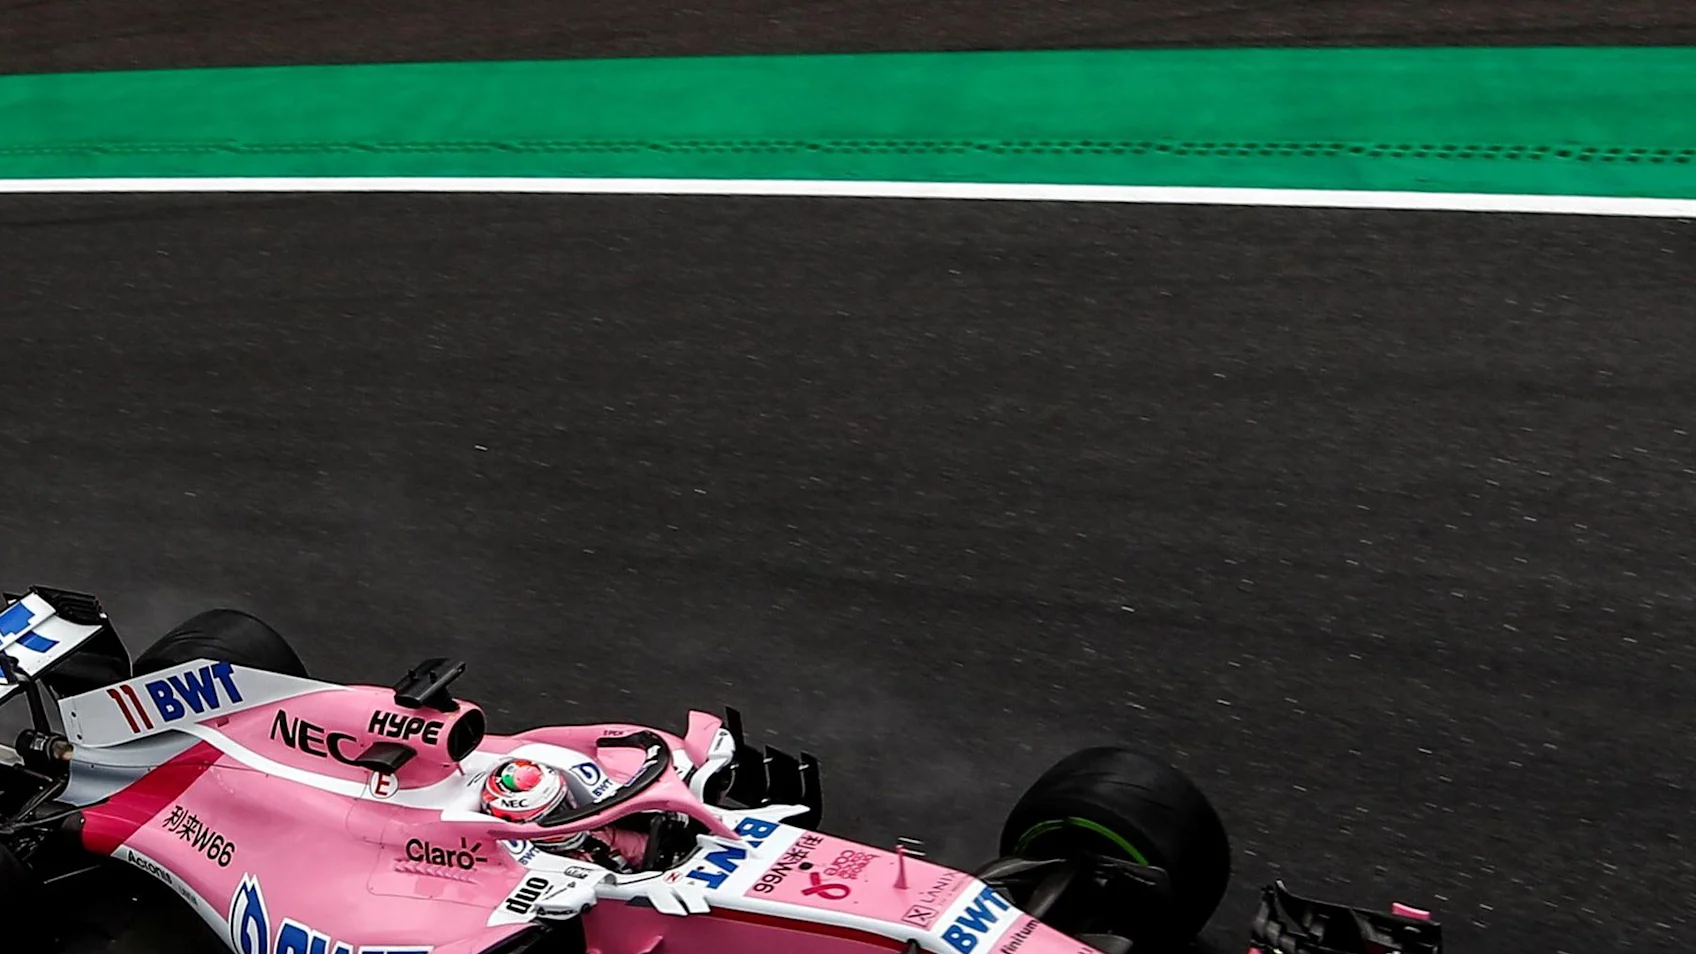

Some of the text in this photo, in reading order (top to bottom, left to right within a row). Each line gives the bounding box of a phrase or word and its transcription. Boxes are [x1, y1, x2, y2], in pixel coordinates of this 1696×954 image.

[106, 661, 243, 734] 11 BWT
[270, 709, 361, 767] NEC
[368, 711, 445, 745] HYPE
[374, 772, 391, 796] E
[500, 799, 529, 808] NEC
[406, 837, 487, 870] Claro
[506, 877, 549, 914] duo
